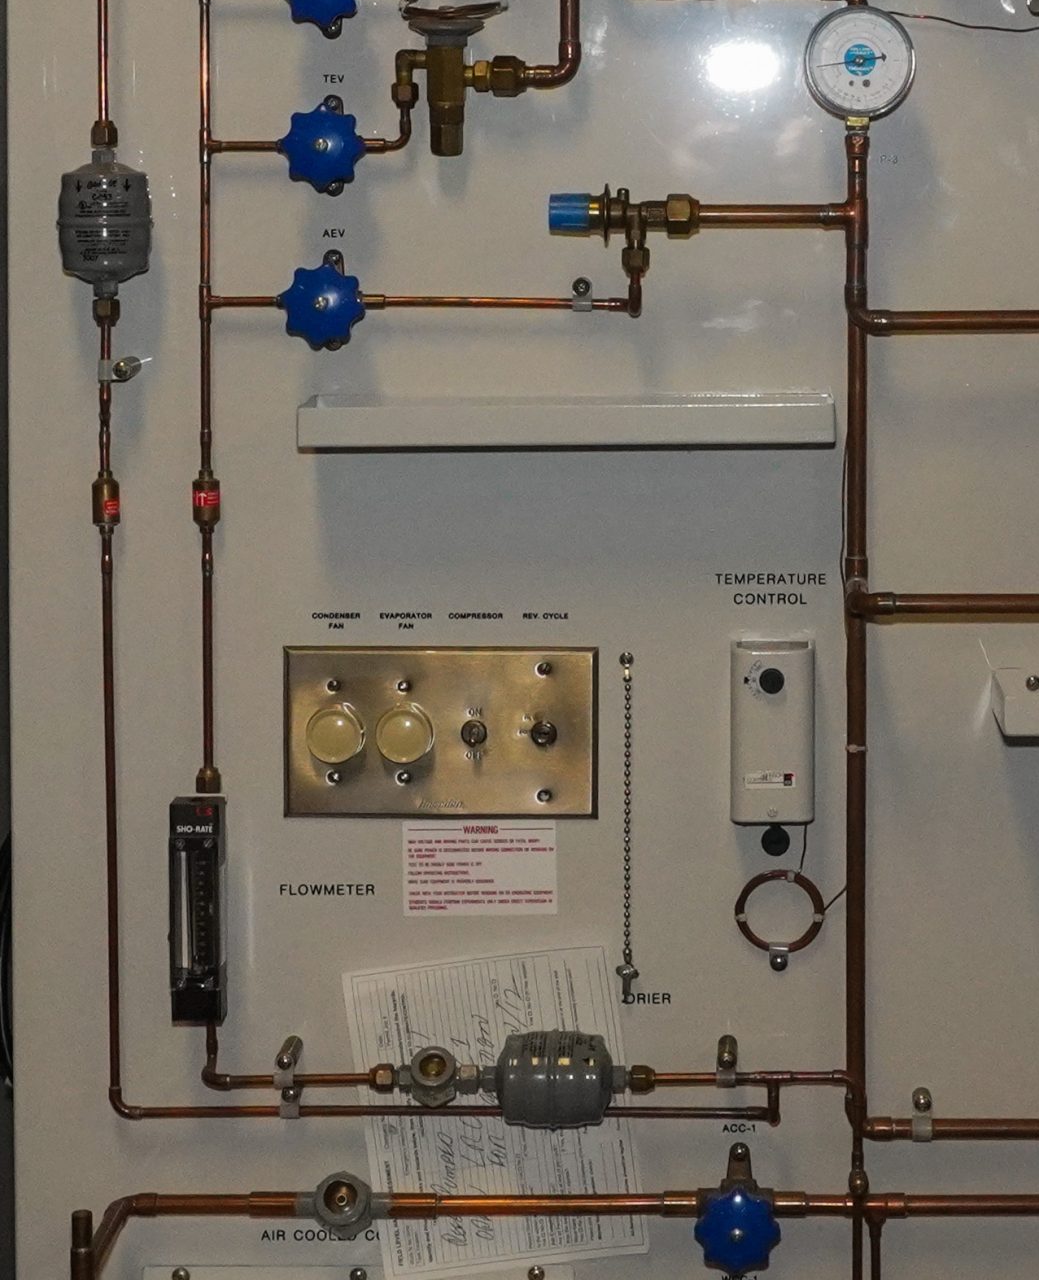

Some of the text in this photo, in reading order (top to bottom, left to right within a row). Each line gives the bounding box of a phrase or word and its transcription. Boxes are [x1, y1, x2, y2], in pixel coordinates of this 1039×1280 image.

[322, 74, 345, 84] TEV
[322, 228, 346, 239] AEV
[715, 573, 827, 586] TEMPERATURE
[733, 593, 808, 605] CONTROL
[311, 612, 361, 620] CONDENSER
[379, 612, 433, 620] EVAPORATOR
[448, 612, 504, 620] COMPRESSOR
[522, 612, 569, 620] REV. CYCLE
[328, 622, 345, 630] FAN
[398, 622, 415, 630] FAN
[176, 824, 214, 834] SHO-RATE
[462, 825, 499, 835] WARNING
[279, 883, 376, 896] FLOWMETER
[722, 1123, 756, 1134] ACC-1
[260, 1229, 286, 1241] AIR
